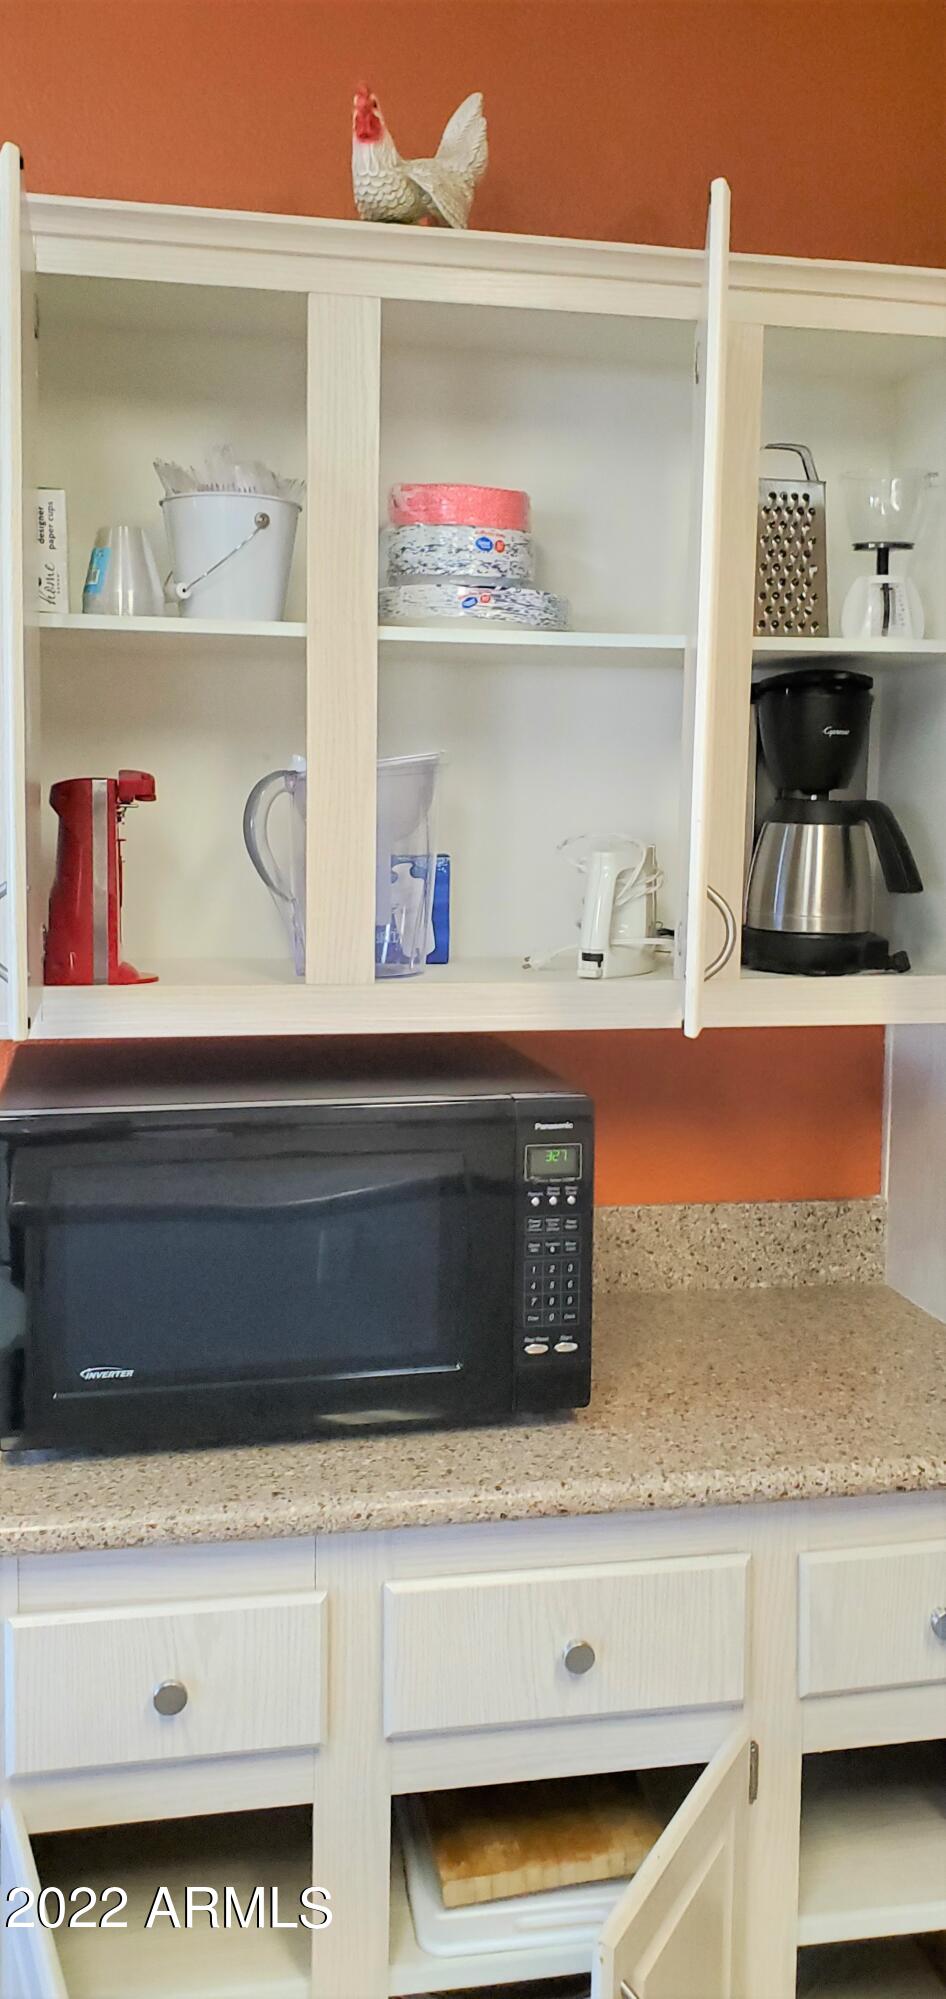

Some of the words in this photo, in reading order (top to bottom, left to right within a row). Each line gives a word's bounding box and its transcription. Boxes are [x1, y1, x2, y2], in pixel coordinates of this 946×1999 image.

[47, 501, 57, 522] cups
[38, 506, 46, 544] designer
[48, 524, 57, 550] paper
[535, 1122, 573, 1130] Panasonic
[84, 1369, 134, 1380] INVERTER
